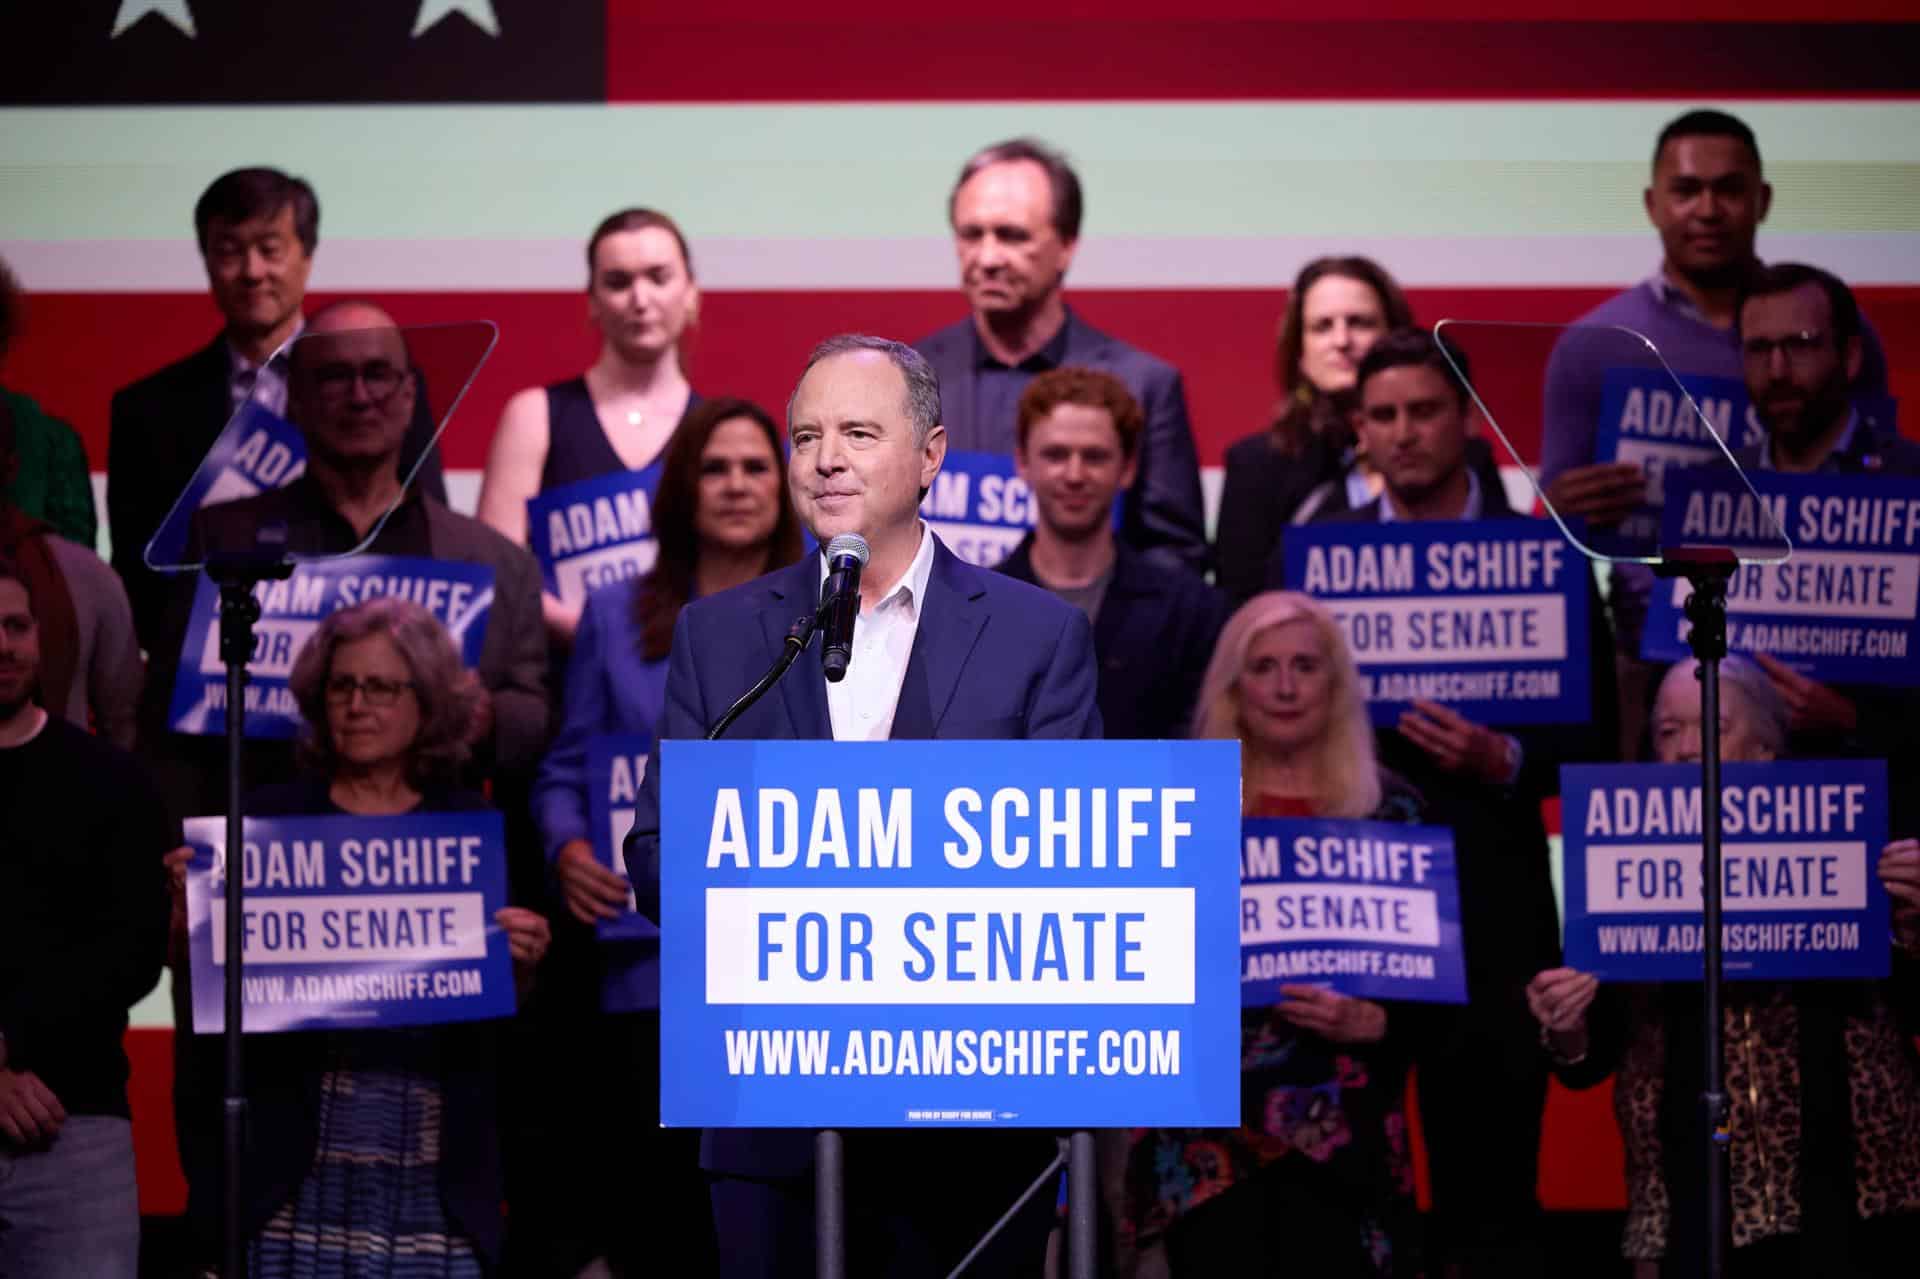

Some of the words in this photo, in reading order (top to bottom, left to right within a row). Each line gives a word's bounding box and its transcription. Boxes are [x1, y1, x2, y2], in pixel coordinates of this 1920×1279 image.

[1620, 387, 1731, 443] ADAM
[548, 489, 652, 558] ADAM
[1682, 491, 1787, 537] ADAM
[1304, 545, 1414, 593] ADAM
[1426, 539, 1565, 590] SCHIFF
[1776, 562, 1896, 606] SENATE
[1408, 608, 1539, 649] SENATE
[706, 788, 912, 868] ADAM
[943, 787, 1196, 869] SCHIFF
[1585, 787, 1704, 836] ADAM
[1721, 785, 1866, 834] SCHIFF
[340, 836, 482, 889] SCHIFF
[1293, 837, 1434, 883] SCHIFF
[1616, 858, 1684, 900] FOR
[1699, 856, 1839, 899] ENATE
[243, 909, 307, 951] FOR
[322, 907, 457, 949] SENATE
[1276, 895, 1412, 933] SENATE
[757, 912, 873, 982] FOR
[903, 912, 1146, 982] SENATE
[725, 1029, 1181, 1076] WWW.ADAMSCHIFF.COM
